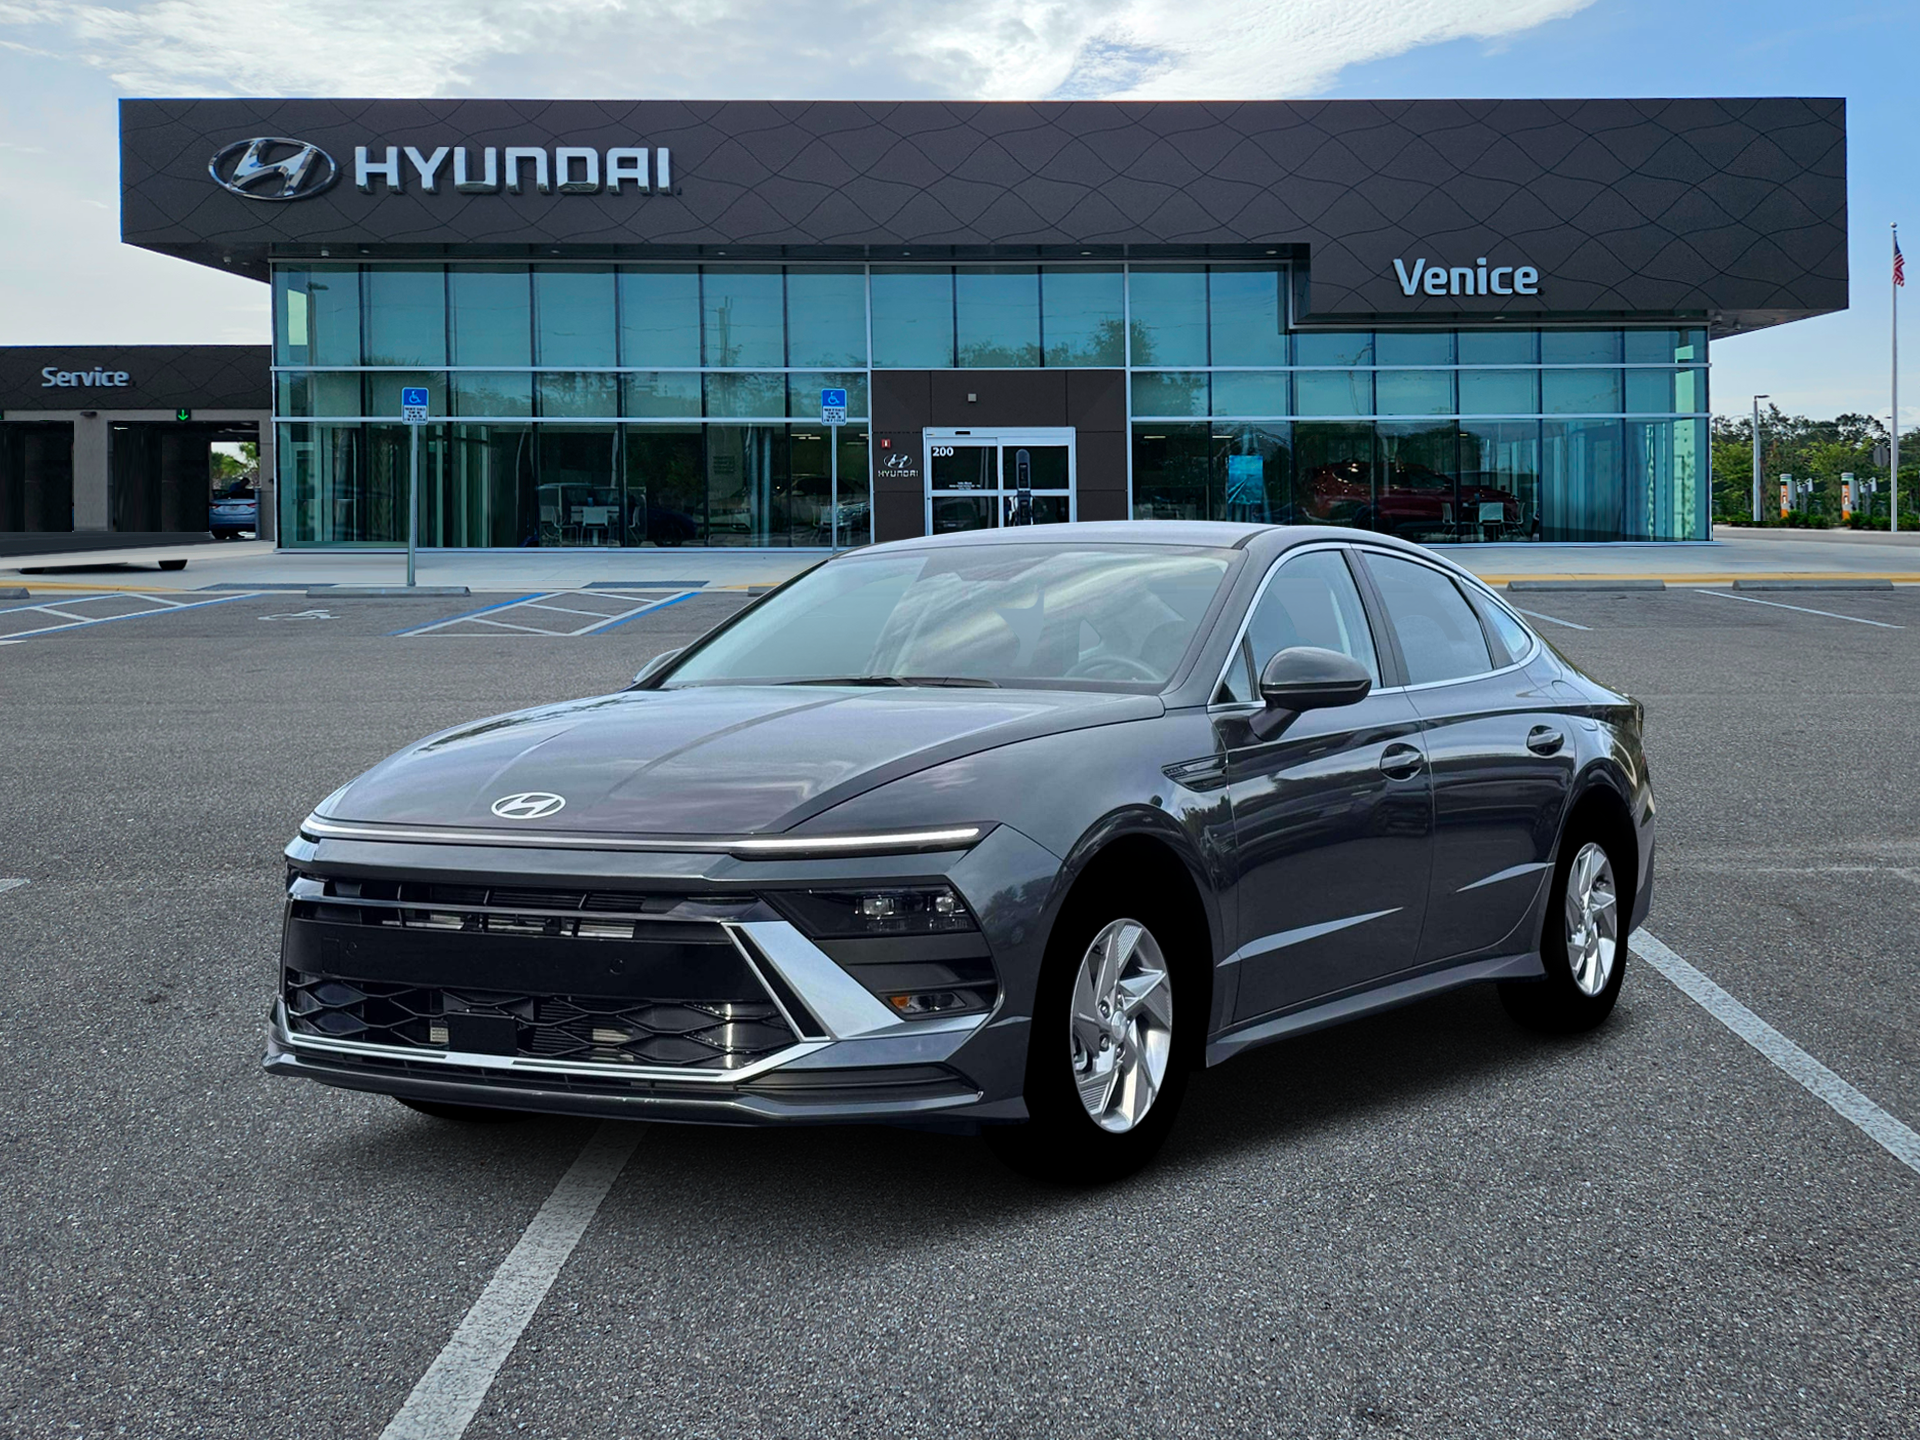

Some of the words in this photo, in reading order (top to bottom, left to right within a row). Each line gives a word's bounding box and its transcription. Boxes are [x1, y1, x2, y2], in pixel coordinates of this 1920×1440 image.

[354, 146, 671, 193] HYUNDAI
[1392, 257, 1540, 296] Venice
[41, 366, 130, 388] Service
[932, 446, 954, 457] 200
[877, 470, 919, 478] HYUNDAI
